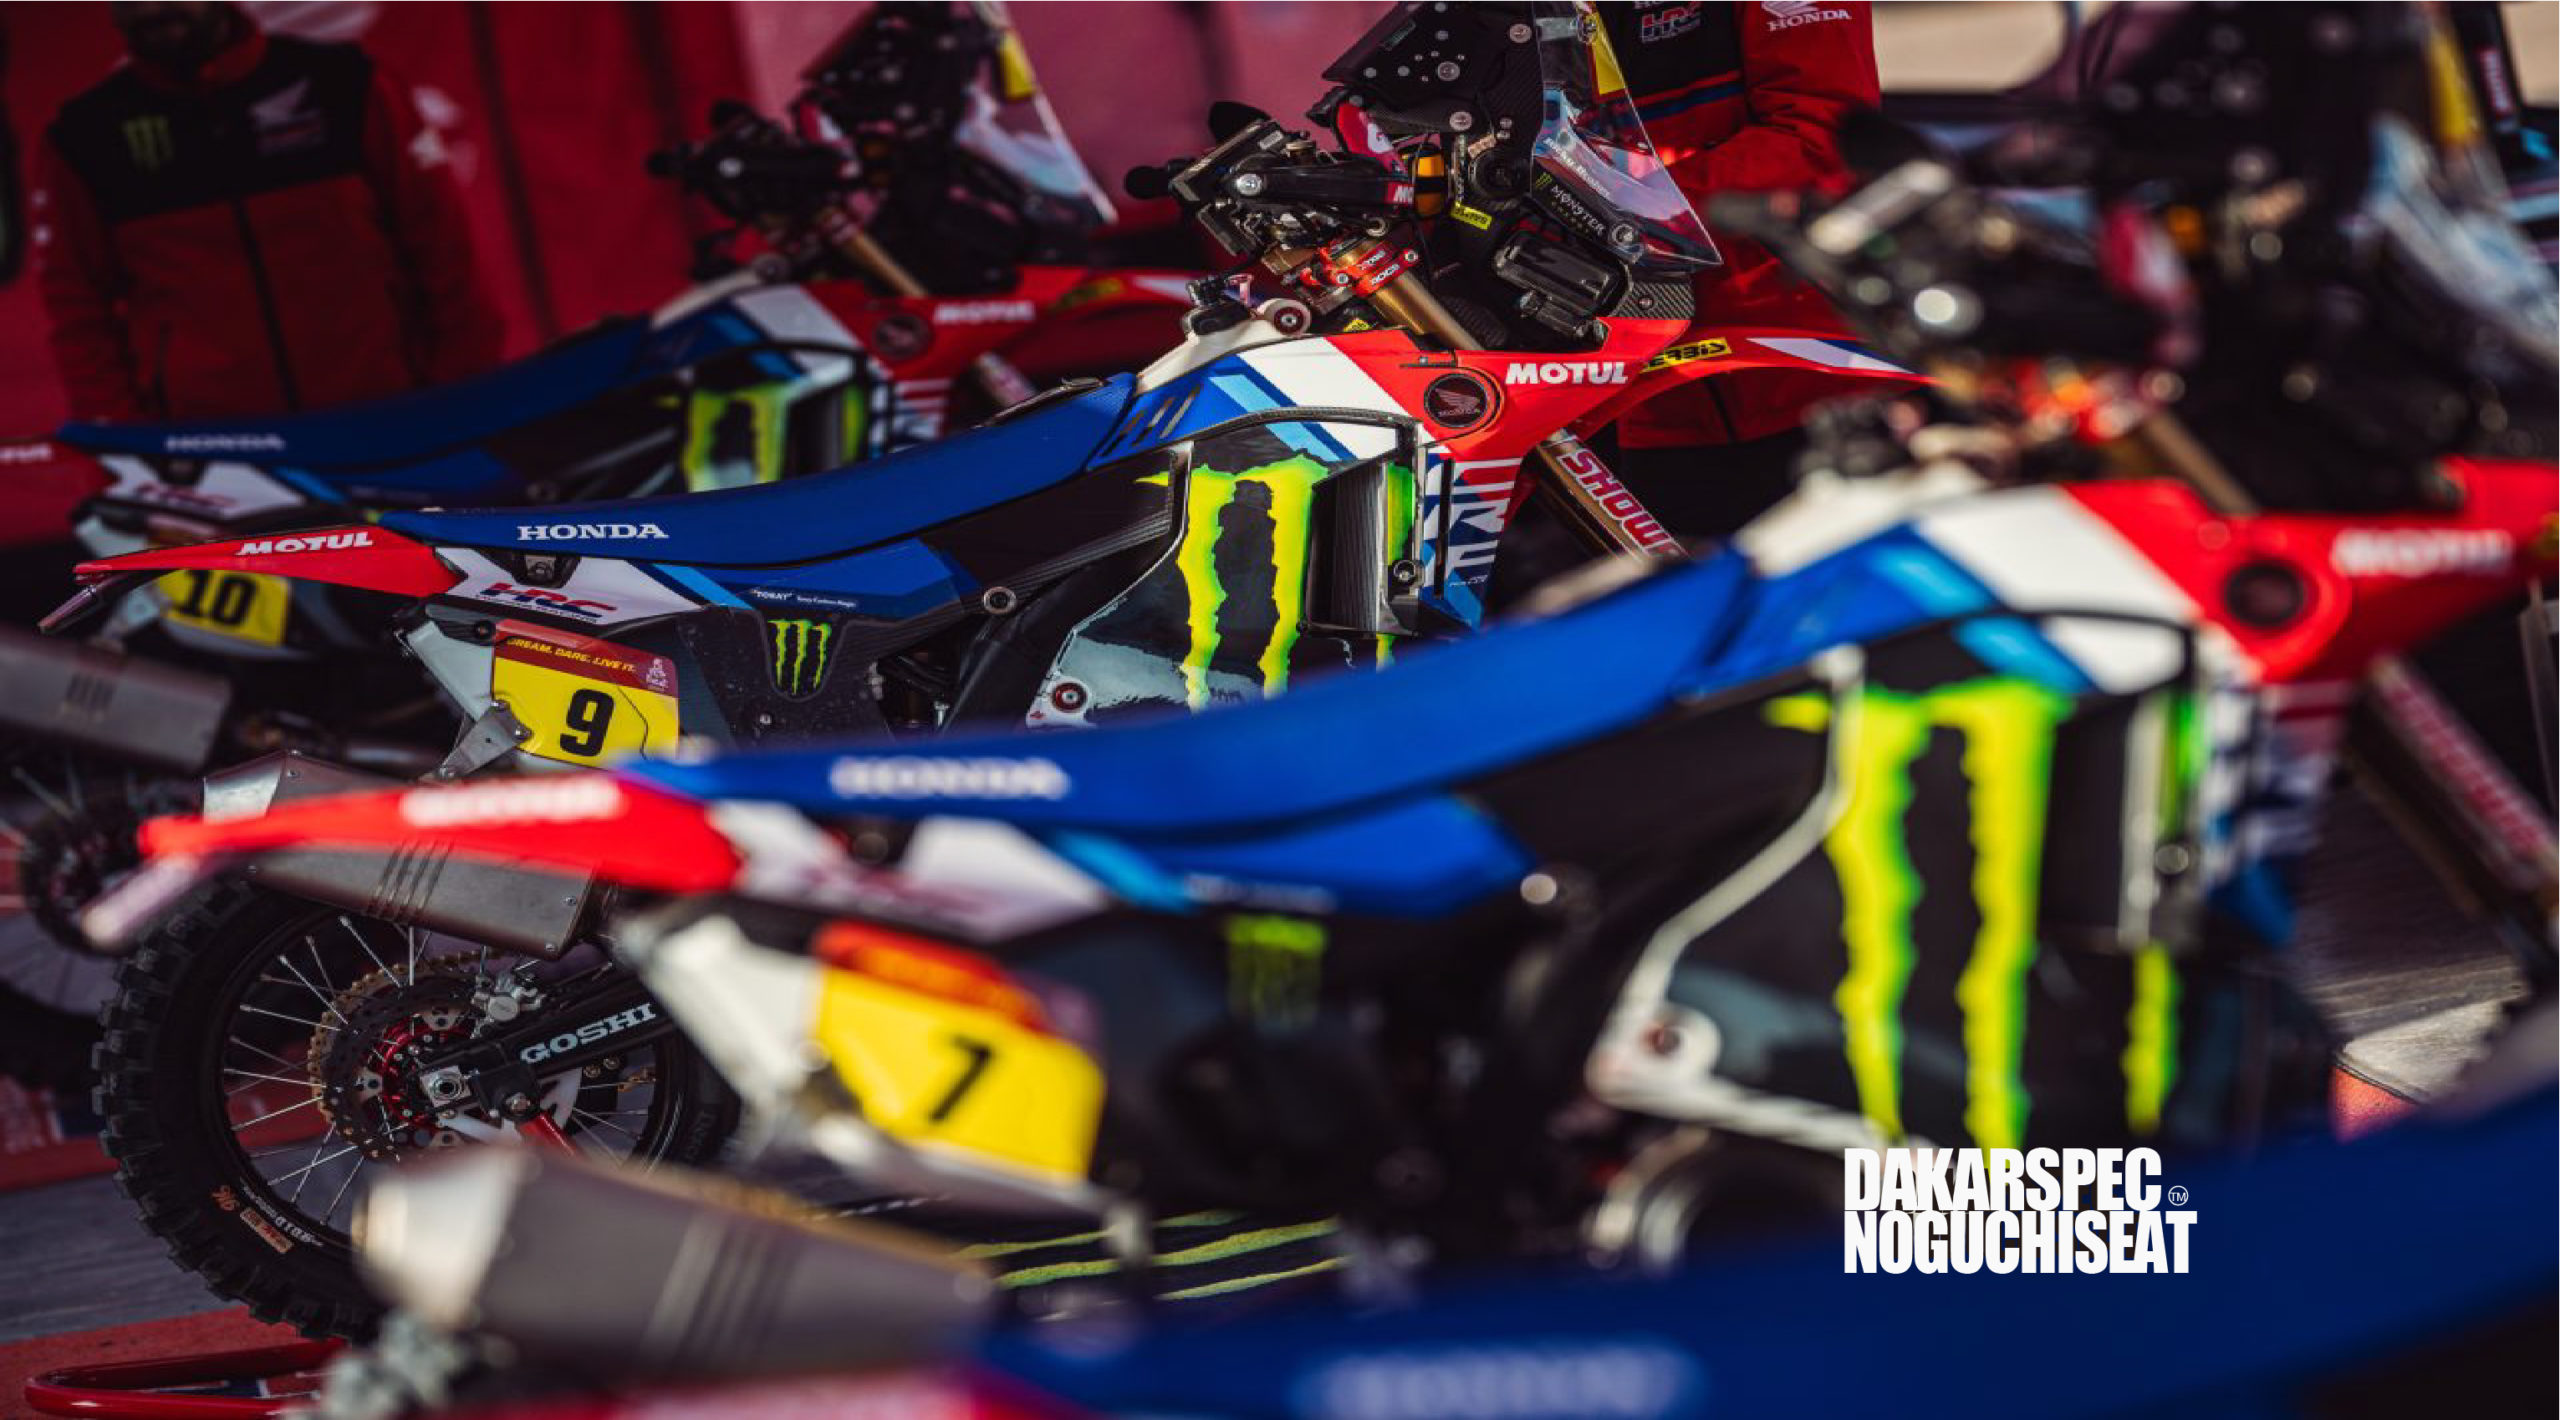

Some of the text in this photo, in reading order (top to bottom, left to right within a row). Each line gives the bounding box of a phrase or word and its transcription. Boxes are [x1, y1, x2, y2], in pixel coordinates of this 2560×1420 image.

[1767, 10, 1852, 32] HONDA
[1551, 185, 1605, 236] MONSTER
[1504, 362, 1628, 385] MOTUL
[235, 532, 374, 556] MOTUL
[516, 523, 669, 541] HONDA
[177, 568, 259, 626] 10
[480, 582, 618, 618] HRC
[592, 656, 619, 670] LIVE
[559, 688, 615, 758] 9
[519, 1003, 657, 1064] GOSHI
